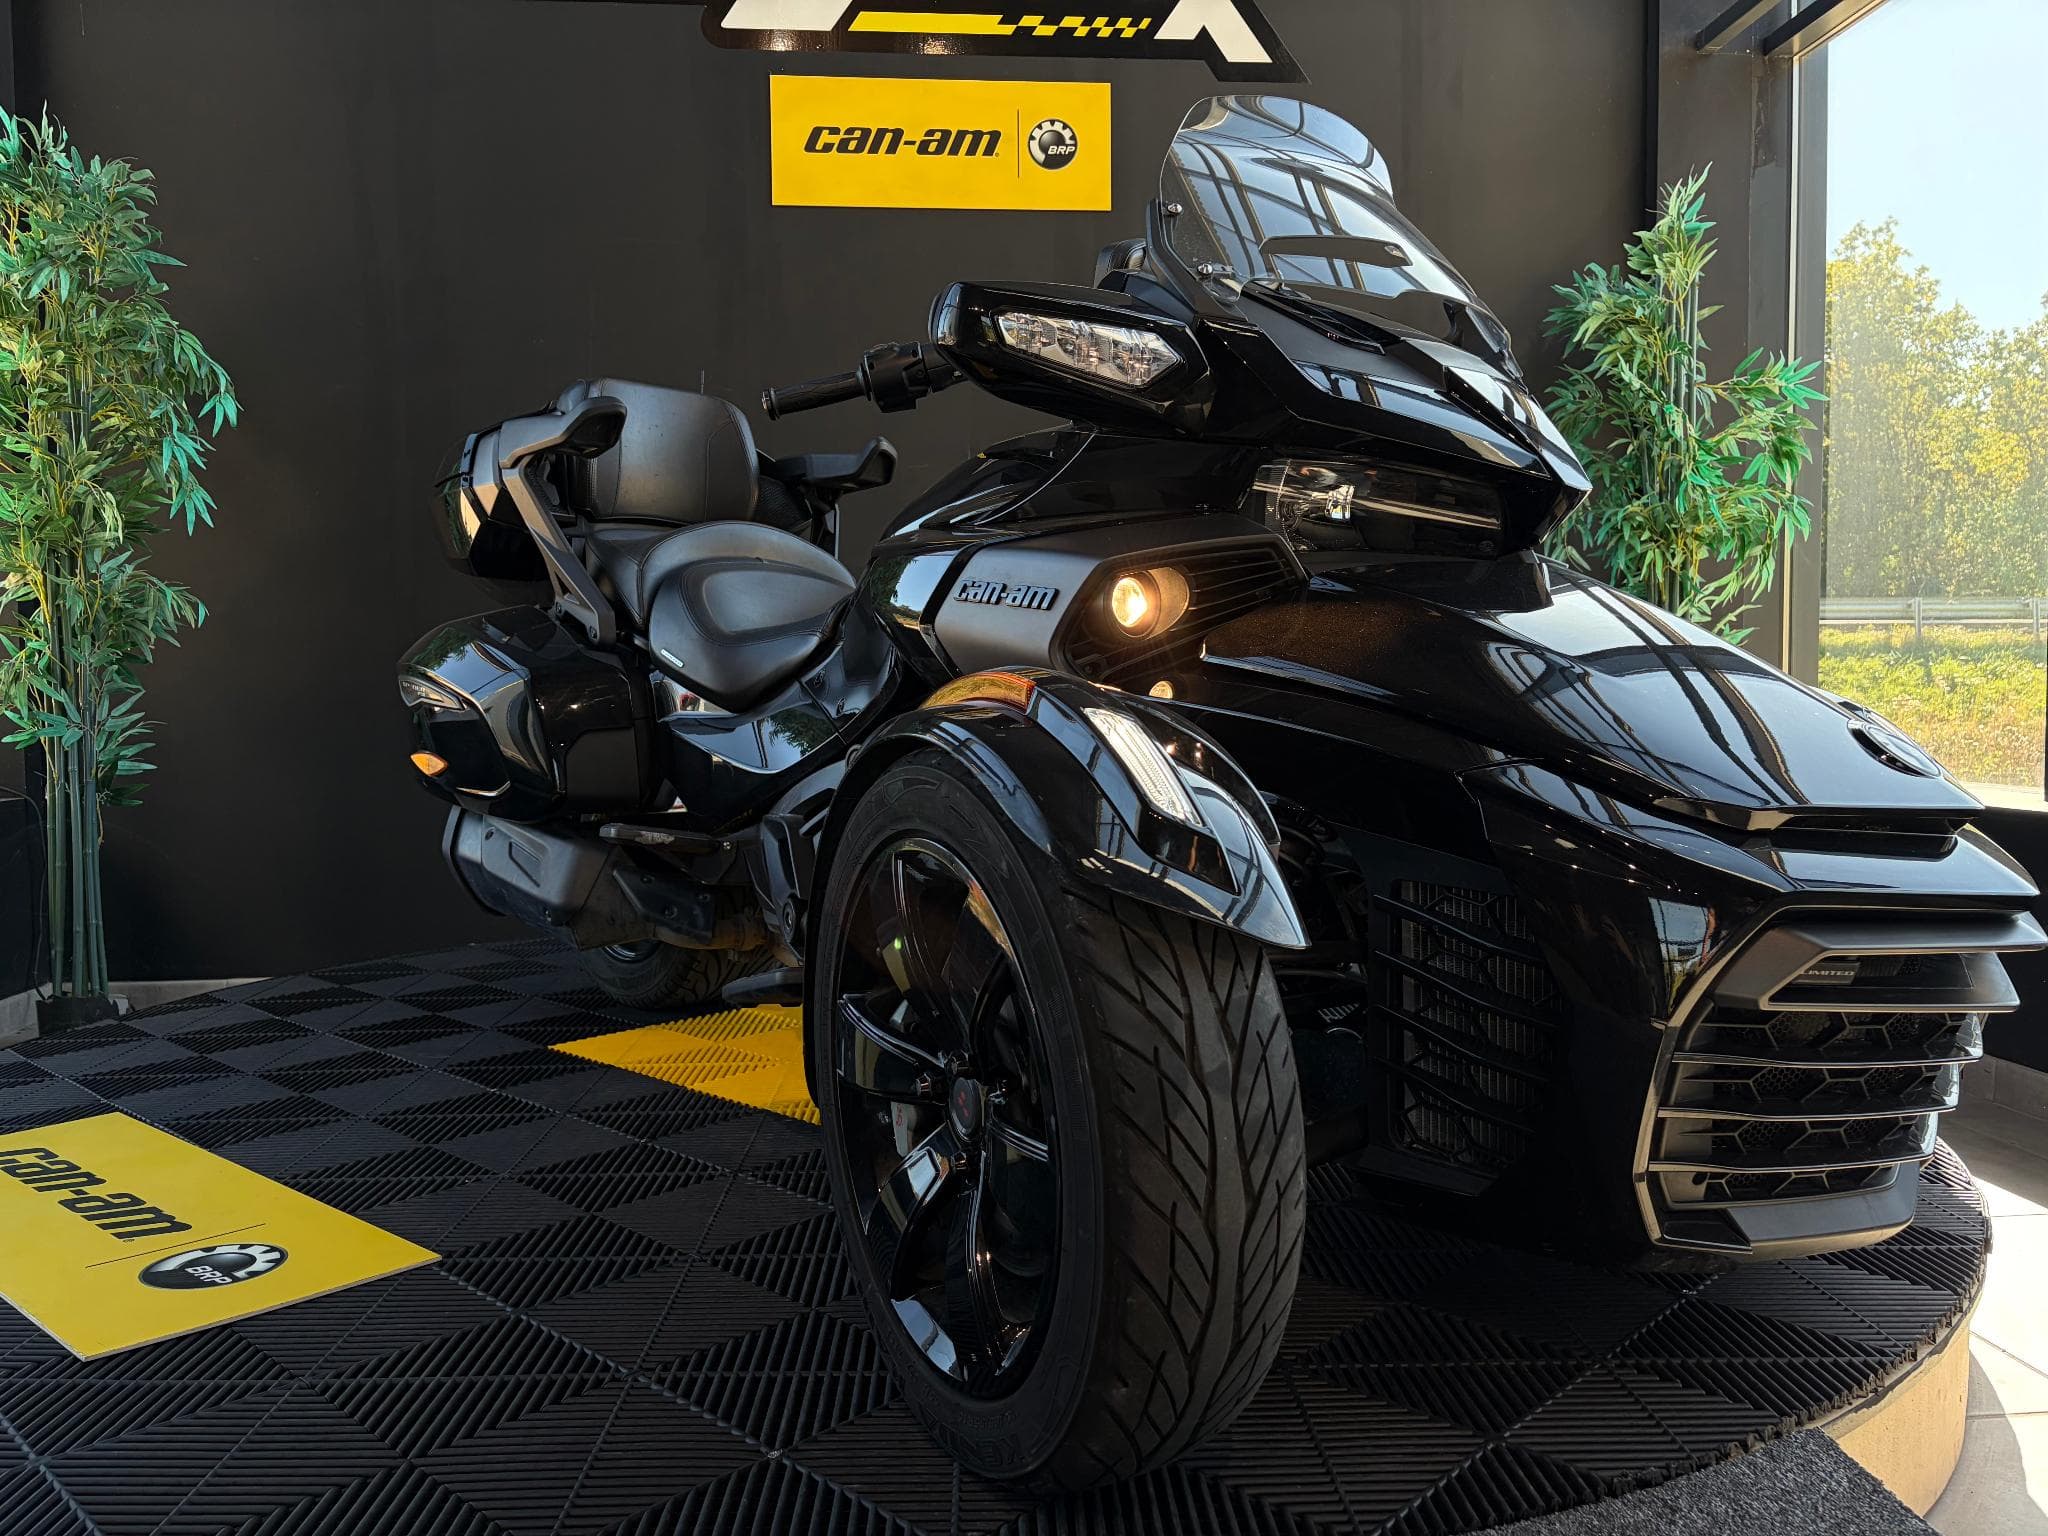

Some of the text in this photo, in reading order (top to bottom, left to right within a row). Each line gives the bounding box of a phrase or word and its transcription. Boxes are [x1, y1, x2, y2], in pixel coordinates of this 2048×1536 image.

[804, 126, 1002, 157] can-am
[1048, 145, 1076, 155] BRP
[955, 580, 1059, 611] can-am
[0, 1147, 193, 1240] can-am
[185, 1265, 232, 1284] BRP
